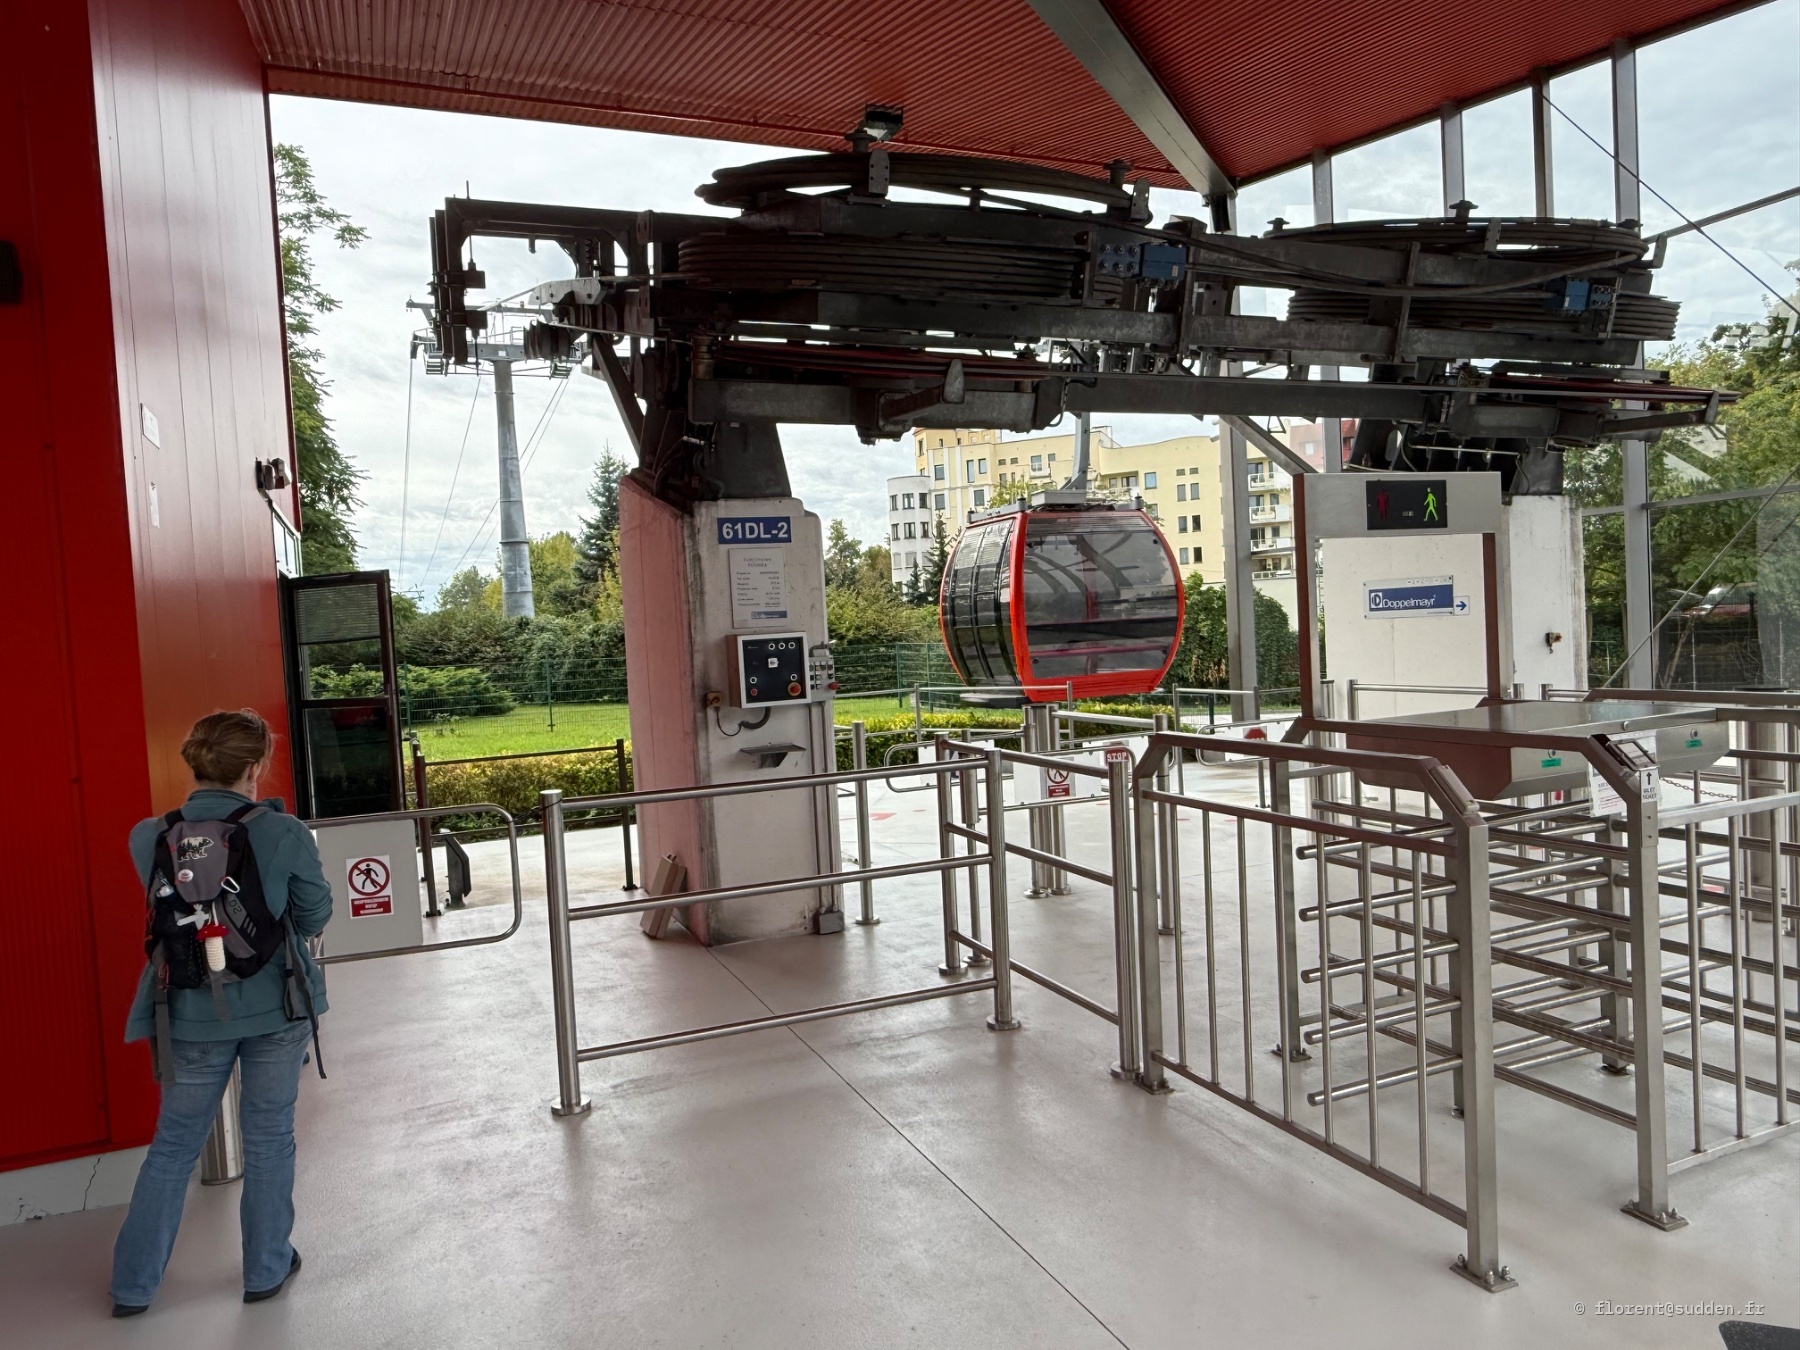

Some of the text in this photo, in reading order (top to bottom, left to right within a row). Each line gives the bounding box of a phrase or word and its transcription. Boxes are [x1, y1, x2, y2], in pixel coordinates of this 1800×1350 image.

[722, 521, 788, 539] 61DL-2
[1382, 597, 1436, 609] Doppelmayr
[1106, 751, 1127, 761] STOP
